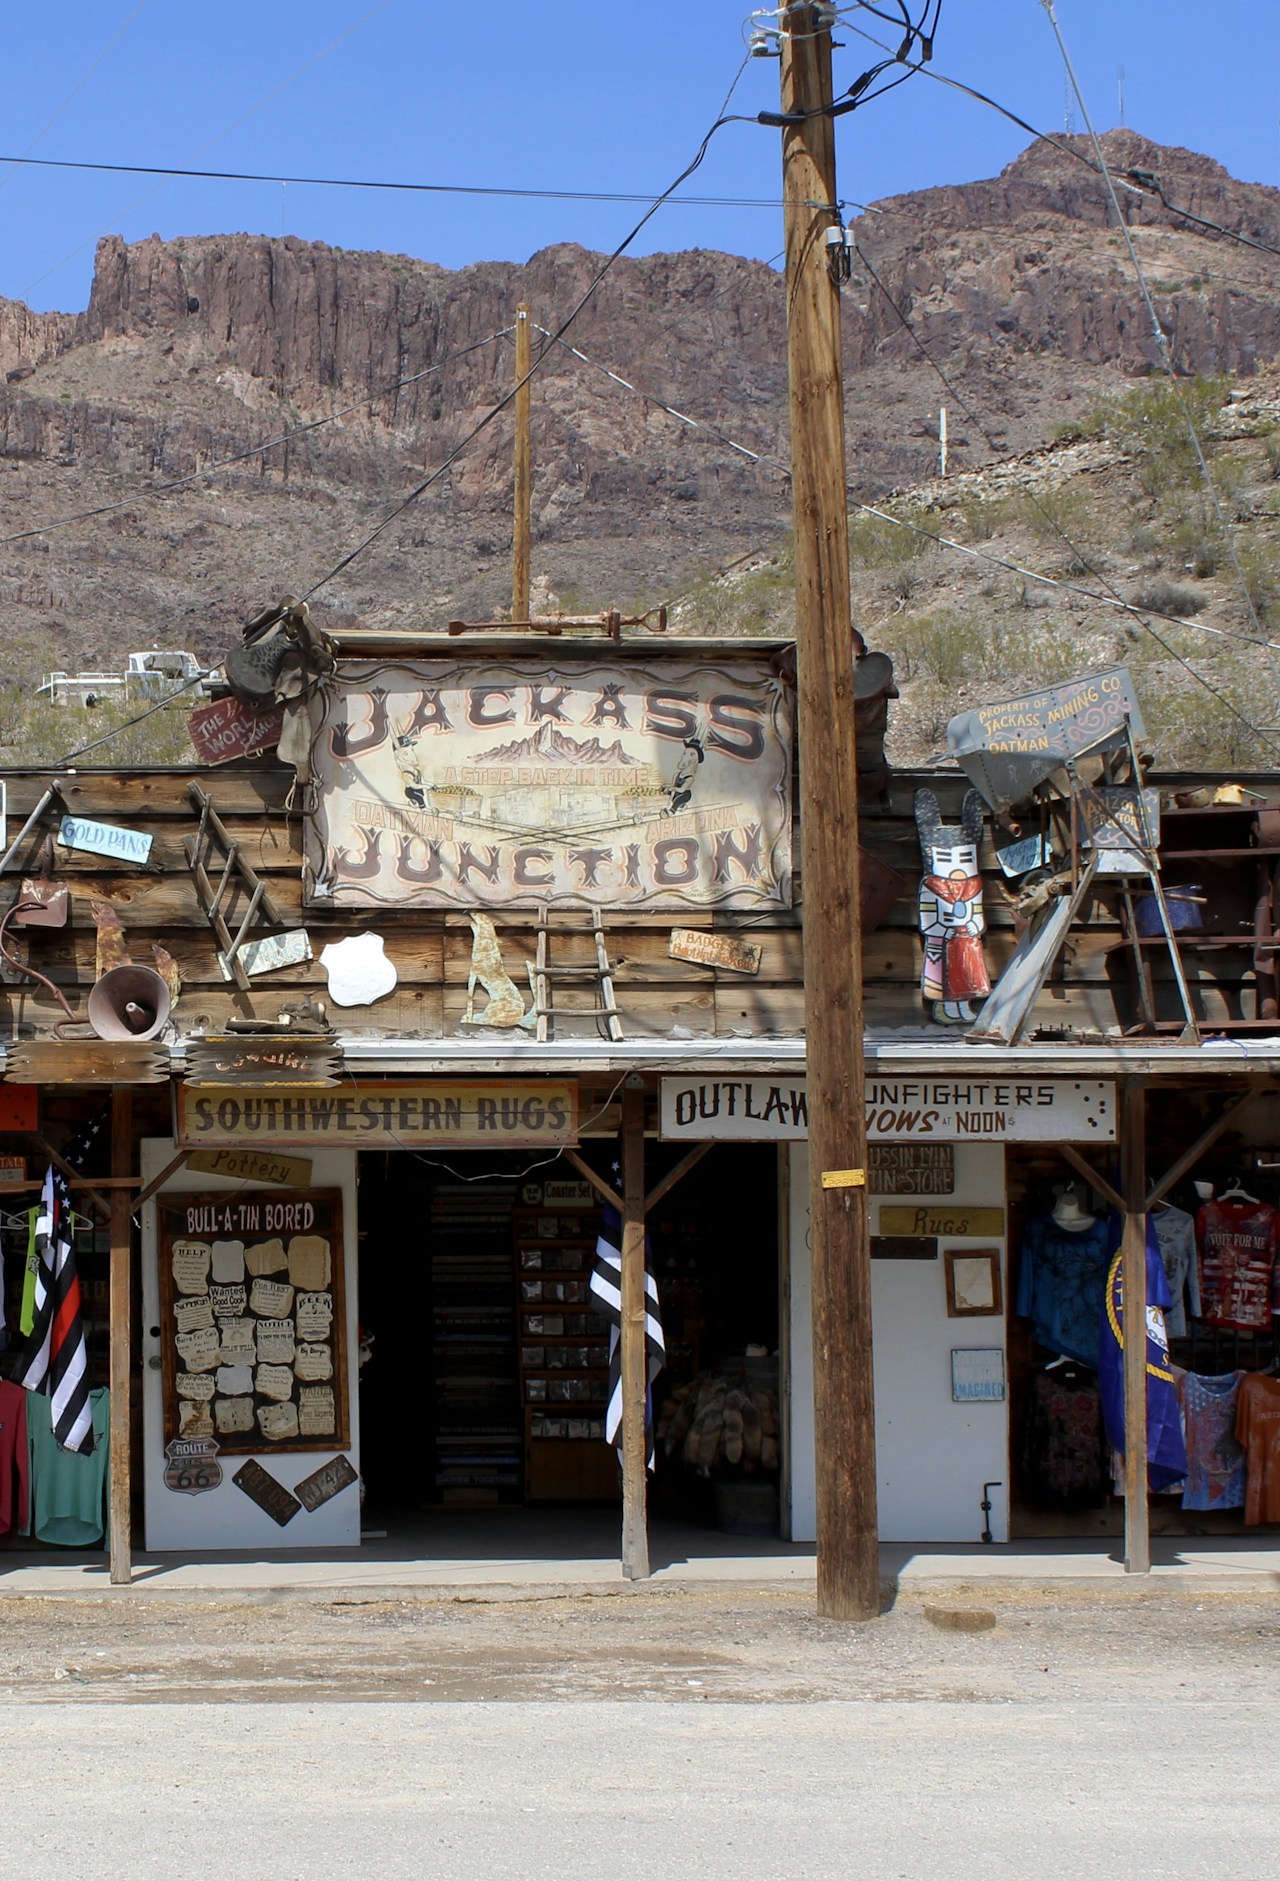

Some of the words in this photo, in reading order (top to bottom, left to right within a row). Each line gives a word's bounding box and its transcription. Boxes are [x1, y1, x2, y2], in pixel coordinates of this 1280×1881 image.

[328, 682, 767, 763] JACKASS
[980, 701, 1030, 723] PROPERTY
[1033, 698, 1049, 709] OF
[983, 713, 1040, 737] JACKASS
[1047, 686, 1099, 725] MINING
[198, 713, 225, 740] THE
[989, 736, 1049, 755] OATMAN
[444, 766, 456, 786] A
[461, 766, 513, 786] STEP
[519, 766, 573, 786] BACK
[577, 766, 597, 786] IN
[600, 766, 649, 786] TIME
[354, 802, 455, 842] OATMAN
[645, 807, 738, 843] ARIZONA
[63, 822, 105, 845] GOLD
[108, 831, 148, 855] PANS
[331, 824, 763, 888] JUNCTION
[194, 1096, 464, 1132] SOUTHWESTERN
[477, 1096, 566, 1132] RUGS
[942, 1116, 952, 1126] AT
[956, 1111, 1006, 1133] NOON
[210, 1150, 291, 1184] Pottery
[919, 1147, 951, 1168] LYIN
[545, 1182, 577, 1199] Coaster
[578, 1182, 591, 1199] Set
[903, 1168, 953, 1193] STORE
[186, 1205, 261, 1233] BULL-A-TIN
[265, 1202, 315, 1231] BORED
[1210, 1234, 1232, 1247] VOTE
[1234, 1233, 1252, 1248] FOR
[1254, 1235, 1266, 1250] ME
[210, 1285, 244, 1296] Wanted
[212, 1295, 229, 1306] Good
[229, 1295, 245, 1305] Cook
[258, 1320, 293, 1329] NOTICE
[175, 1443, 209, 1455] ROUTE
[176, 1467, 210, 1489] 66
